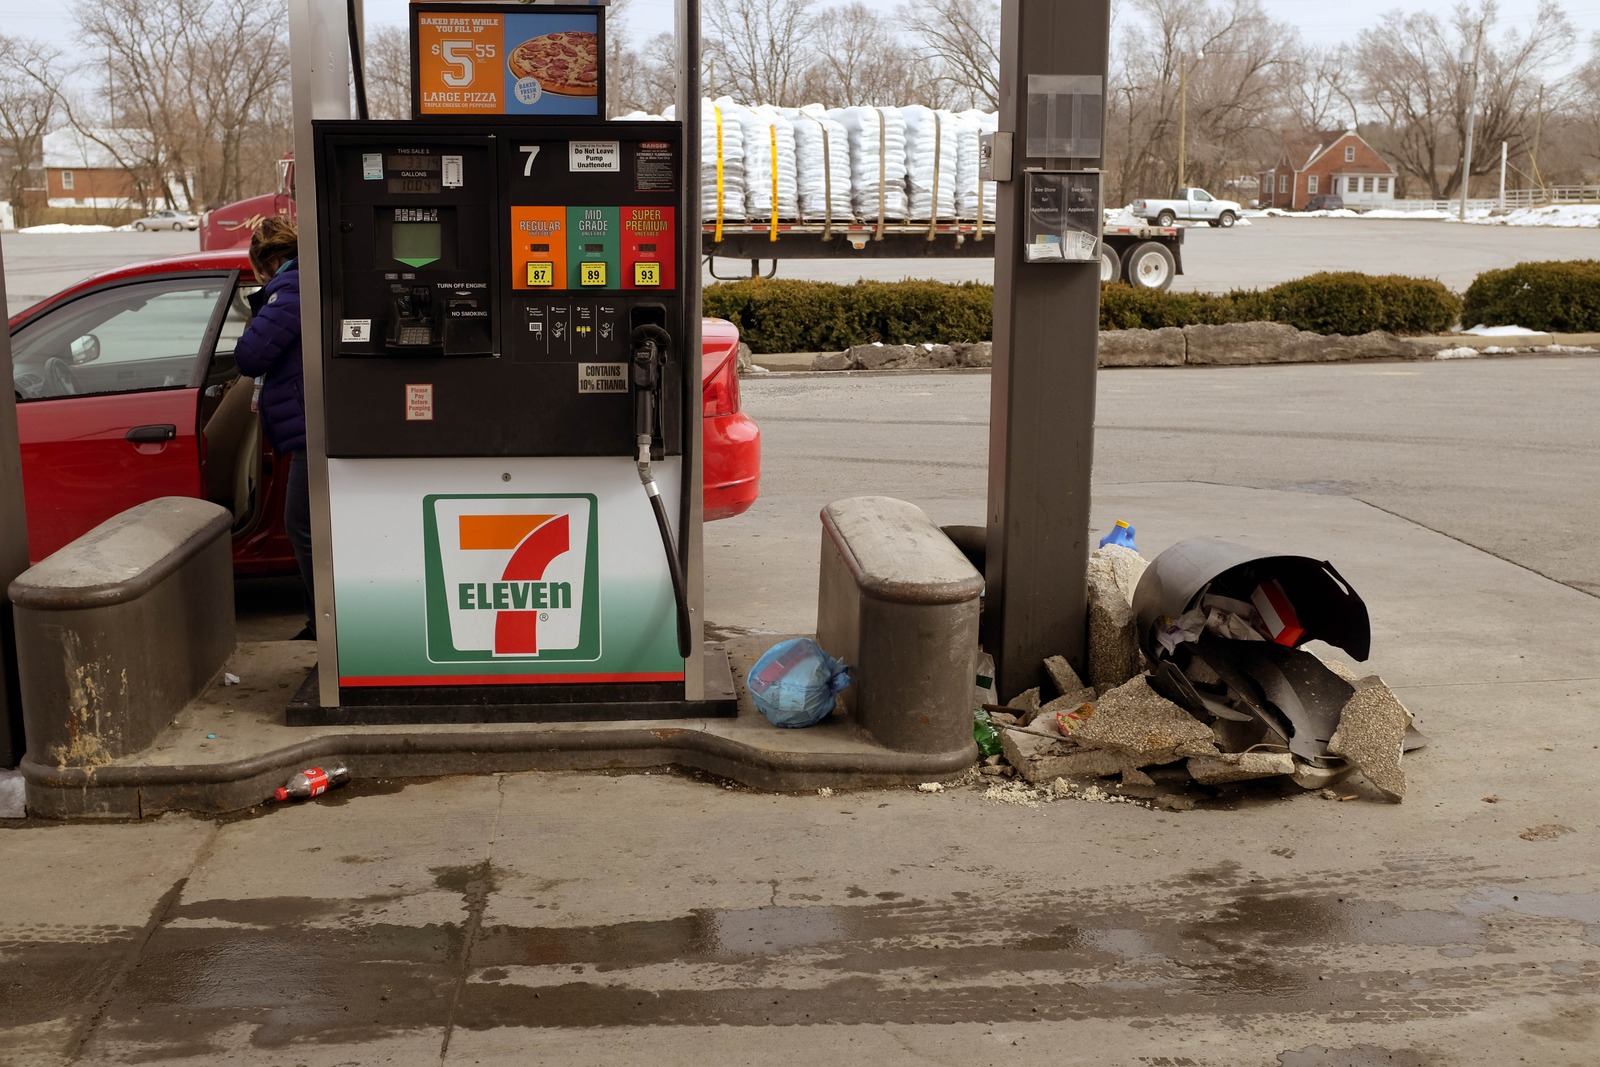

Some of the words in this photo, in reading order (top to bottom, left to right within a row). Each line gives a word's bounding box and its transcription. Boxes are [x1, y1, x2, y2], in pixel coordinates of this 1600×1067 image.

[449, 18, 469, 26] FAST
[424, 92, 461, 102] LARGE
[464, 92, 496, 102] PIZZA
[519, 145, 540, 177] 7
[584, 209, 602, 220] MID
[632, 209, 661, 220] SUPER
[519, 220, 561, 231] REGULAR
[578, 220, 608, 231] GRADE
[625, 220, 668, 231] PREMIUM
[533, 270, 546, 280] 87
[587, 270, 600, 280] 89
[641, 270, 653, 280] 93
[585, 365, 621, 377] CONTAINS
[580, 379, 595, 390] 10%
[596, 379, 627, 390] ETHANOL
[459, 514, 570, 654] 7
